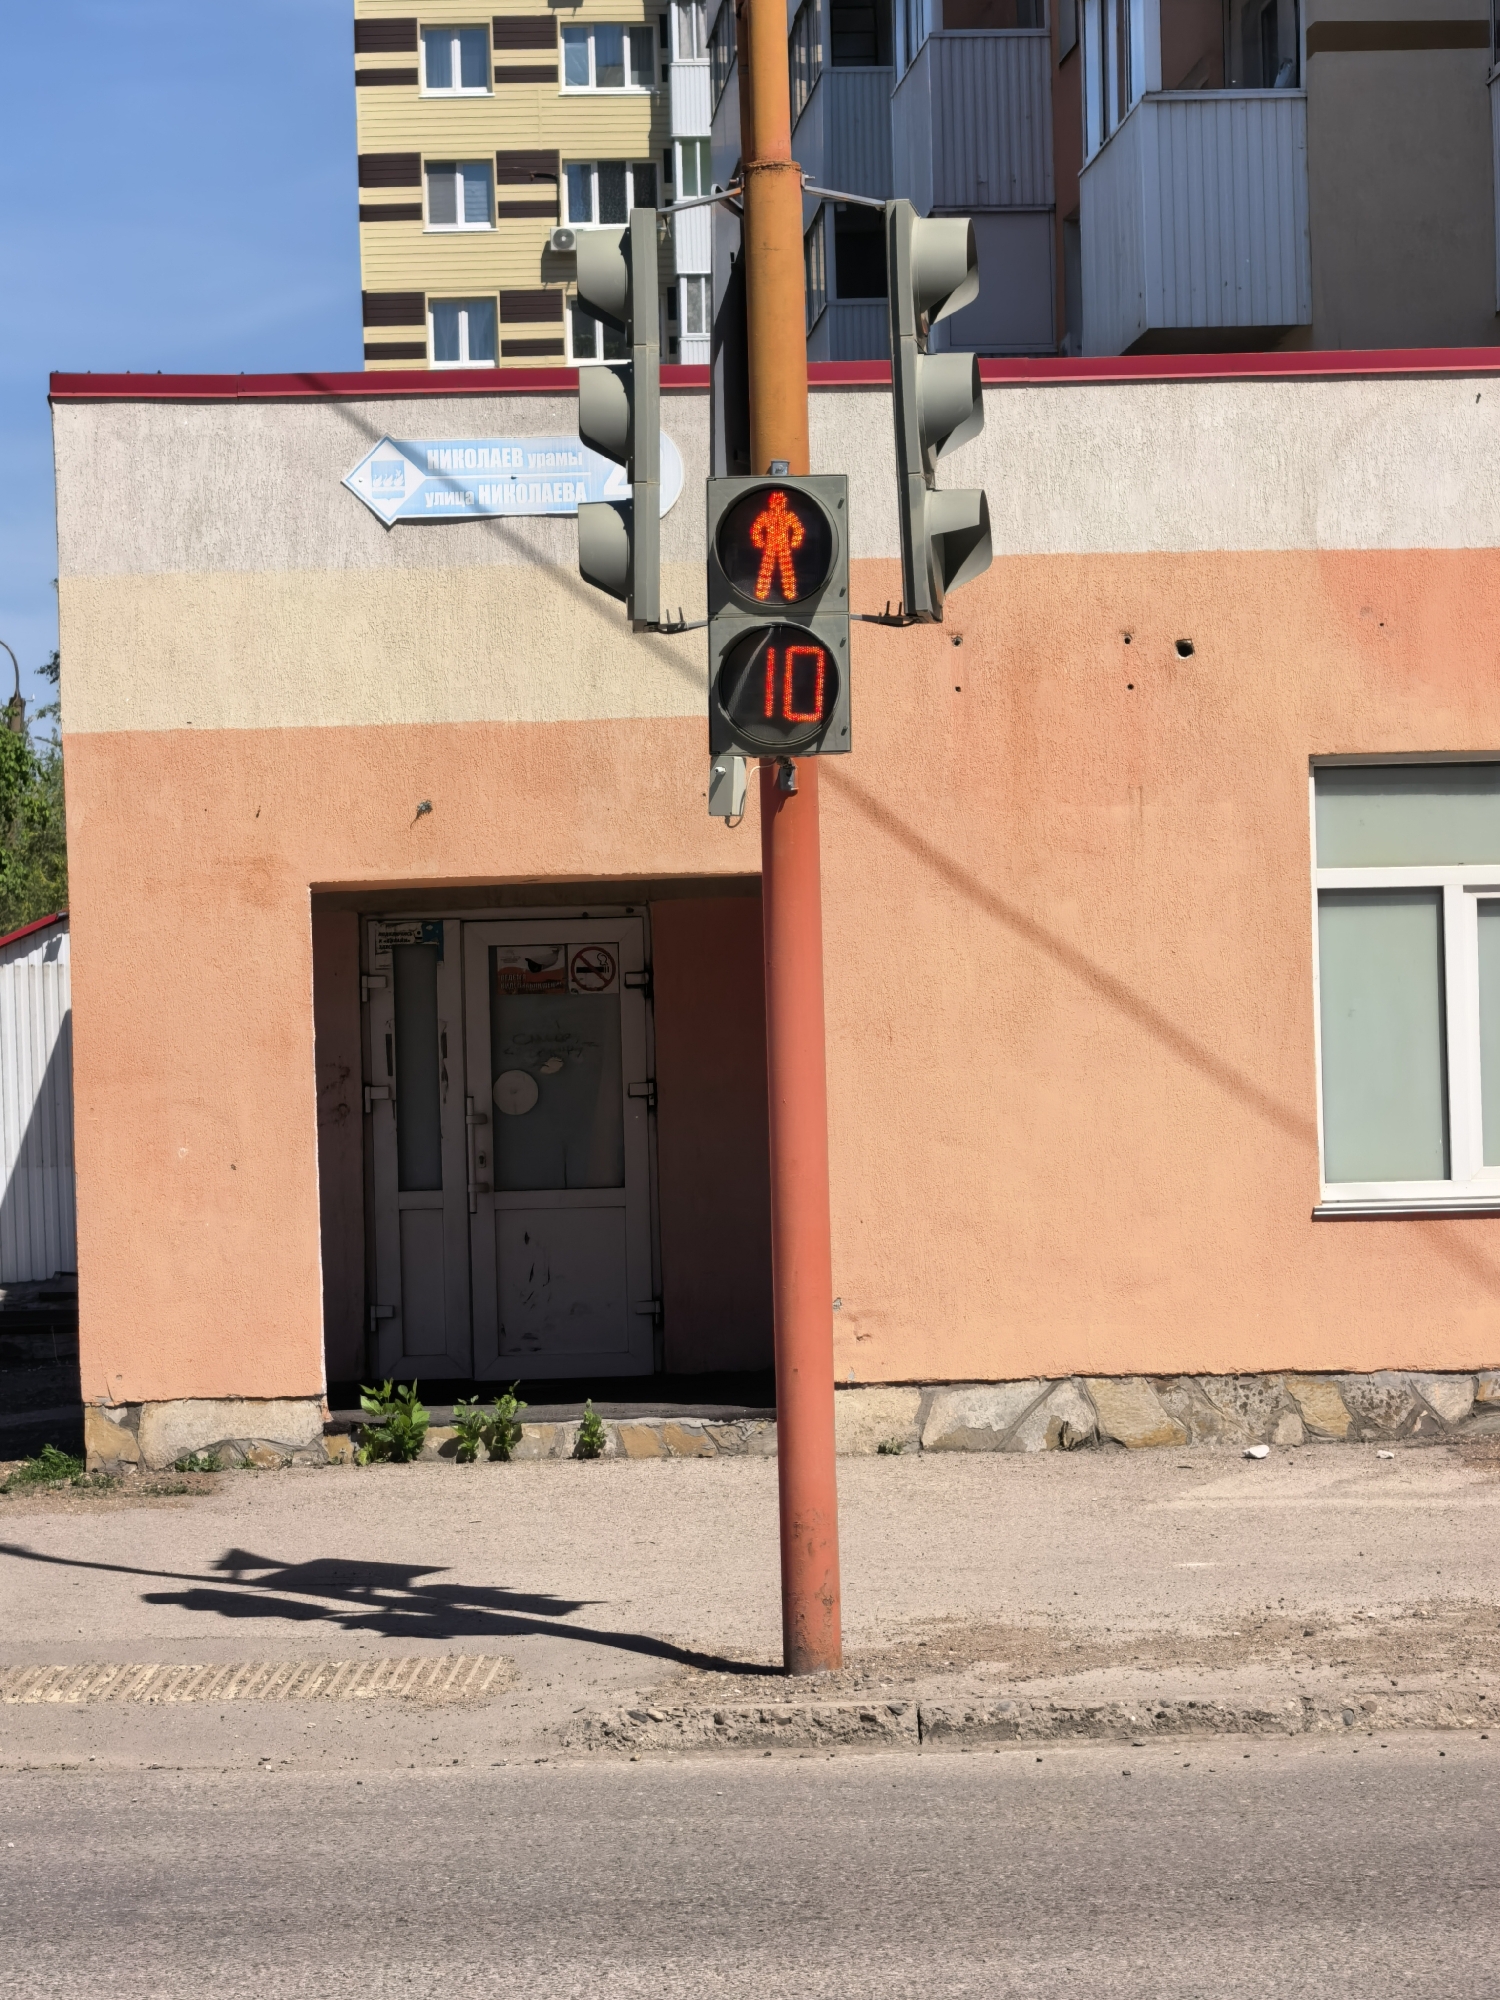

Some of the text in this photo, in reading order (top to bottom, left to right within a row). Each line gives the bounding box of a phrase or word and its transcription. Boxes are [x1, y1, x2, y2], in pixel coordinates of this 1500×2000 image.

[427, 447, 583, 470] НИКОЛАЕВ урамы
[425, 482, 587, 508] улица НИКОЛАЕВА
[764, 645, 826, 722] 10
